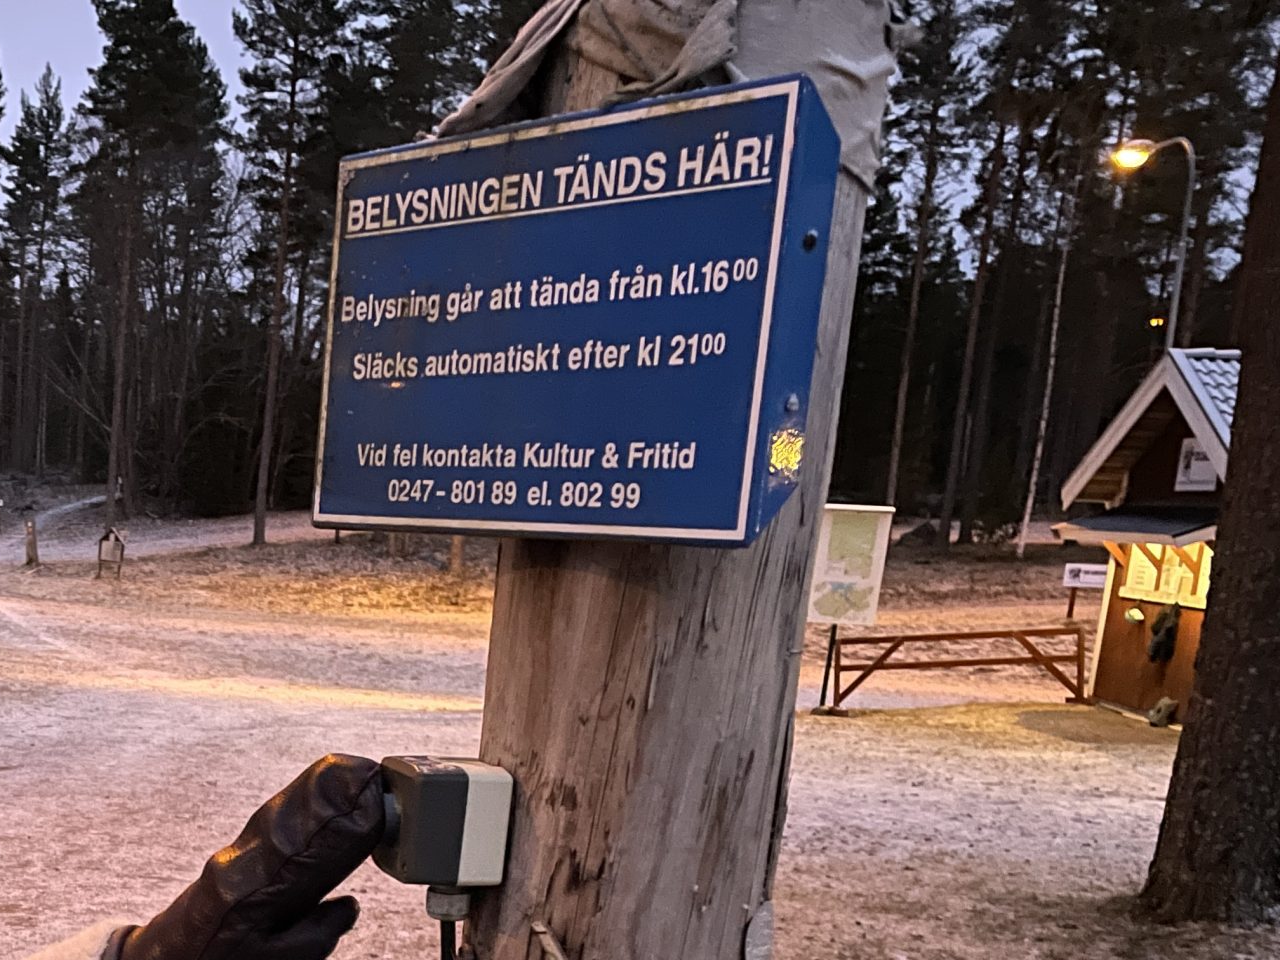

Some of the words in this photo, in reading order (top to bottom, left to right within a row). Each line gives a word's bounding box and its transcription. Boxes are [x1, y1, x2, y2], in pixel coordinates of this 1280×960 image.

[347, 171, 543, 234] BELYSNINGEN
[553, 150, 667, 204] TÄNDS
[677, 132, 774, 184] HÄR!
[446, 286, 483, 322] går
[490, 282, 521, 309] att
[531, 272, 599, 307] tända
[609, 264, 662, 300] från
[352, 346, 418, 381] Släcks
[424, 341, 560, 375] automatiskt
[568, 339, 631, 370] efter
[637, 334, 661, 366] kl
[357, 442, 387, 466] Vid
[392, 443, 416, 466] fel
[422, 443, 516, 467] kontakta
[523, 442, 594, 467] Kultur
[601, 443, 619, 467] &
[627, 442, 695, 468] Fritid
[527, 483, 552, 506] el.
